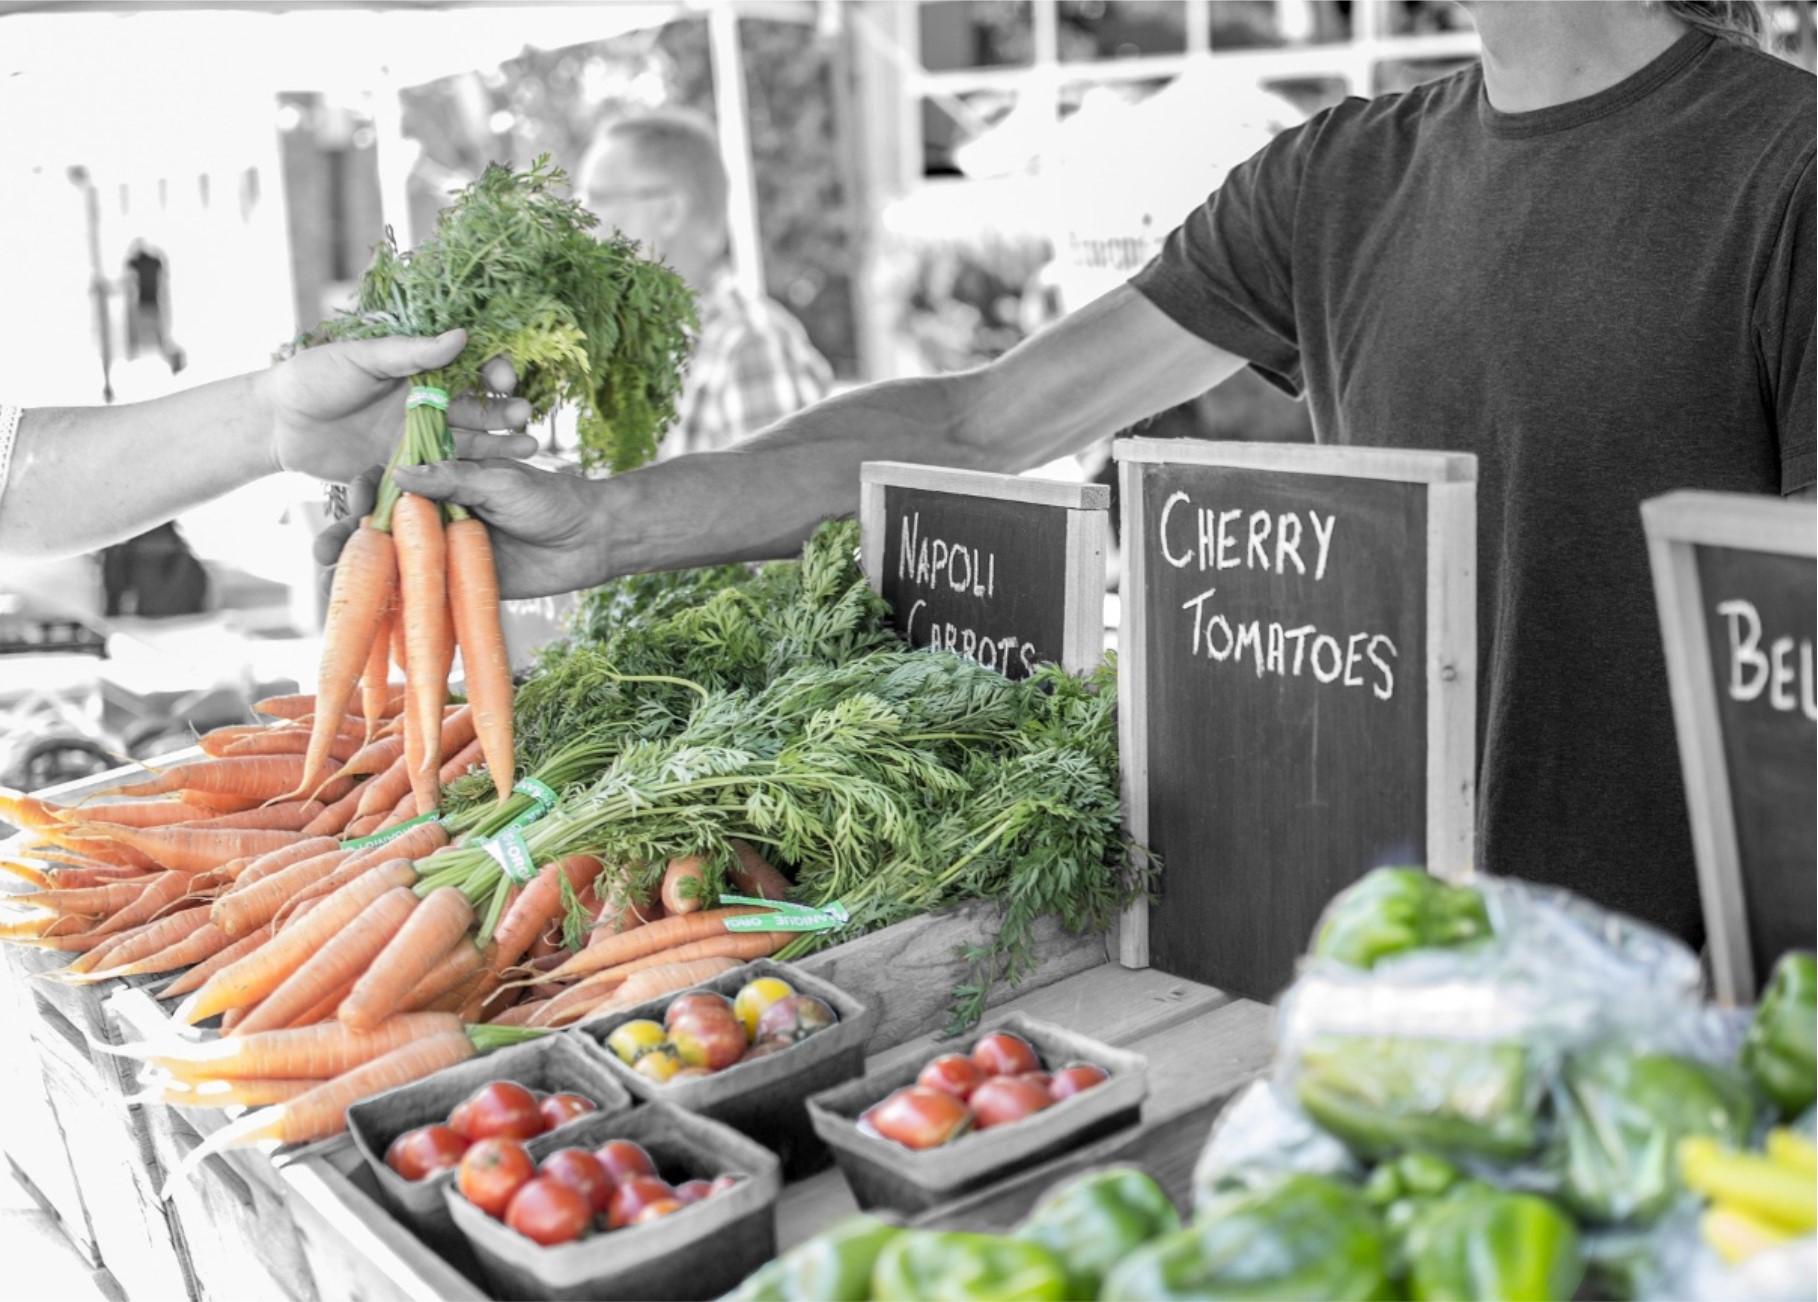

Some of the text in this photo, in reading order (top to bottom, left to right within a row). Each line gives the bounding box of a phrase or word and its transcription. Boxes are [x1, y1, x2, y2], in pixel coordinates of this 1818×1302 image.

[899, 511, 995, 598] NAPOLI
[1159, 490, 1336, 580] CHERRY
[1183, 588, 1398, 700] TOMATOES
